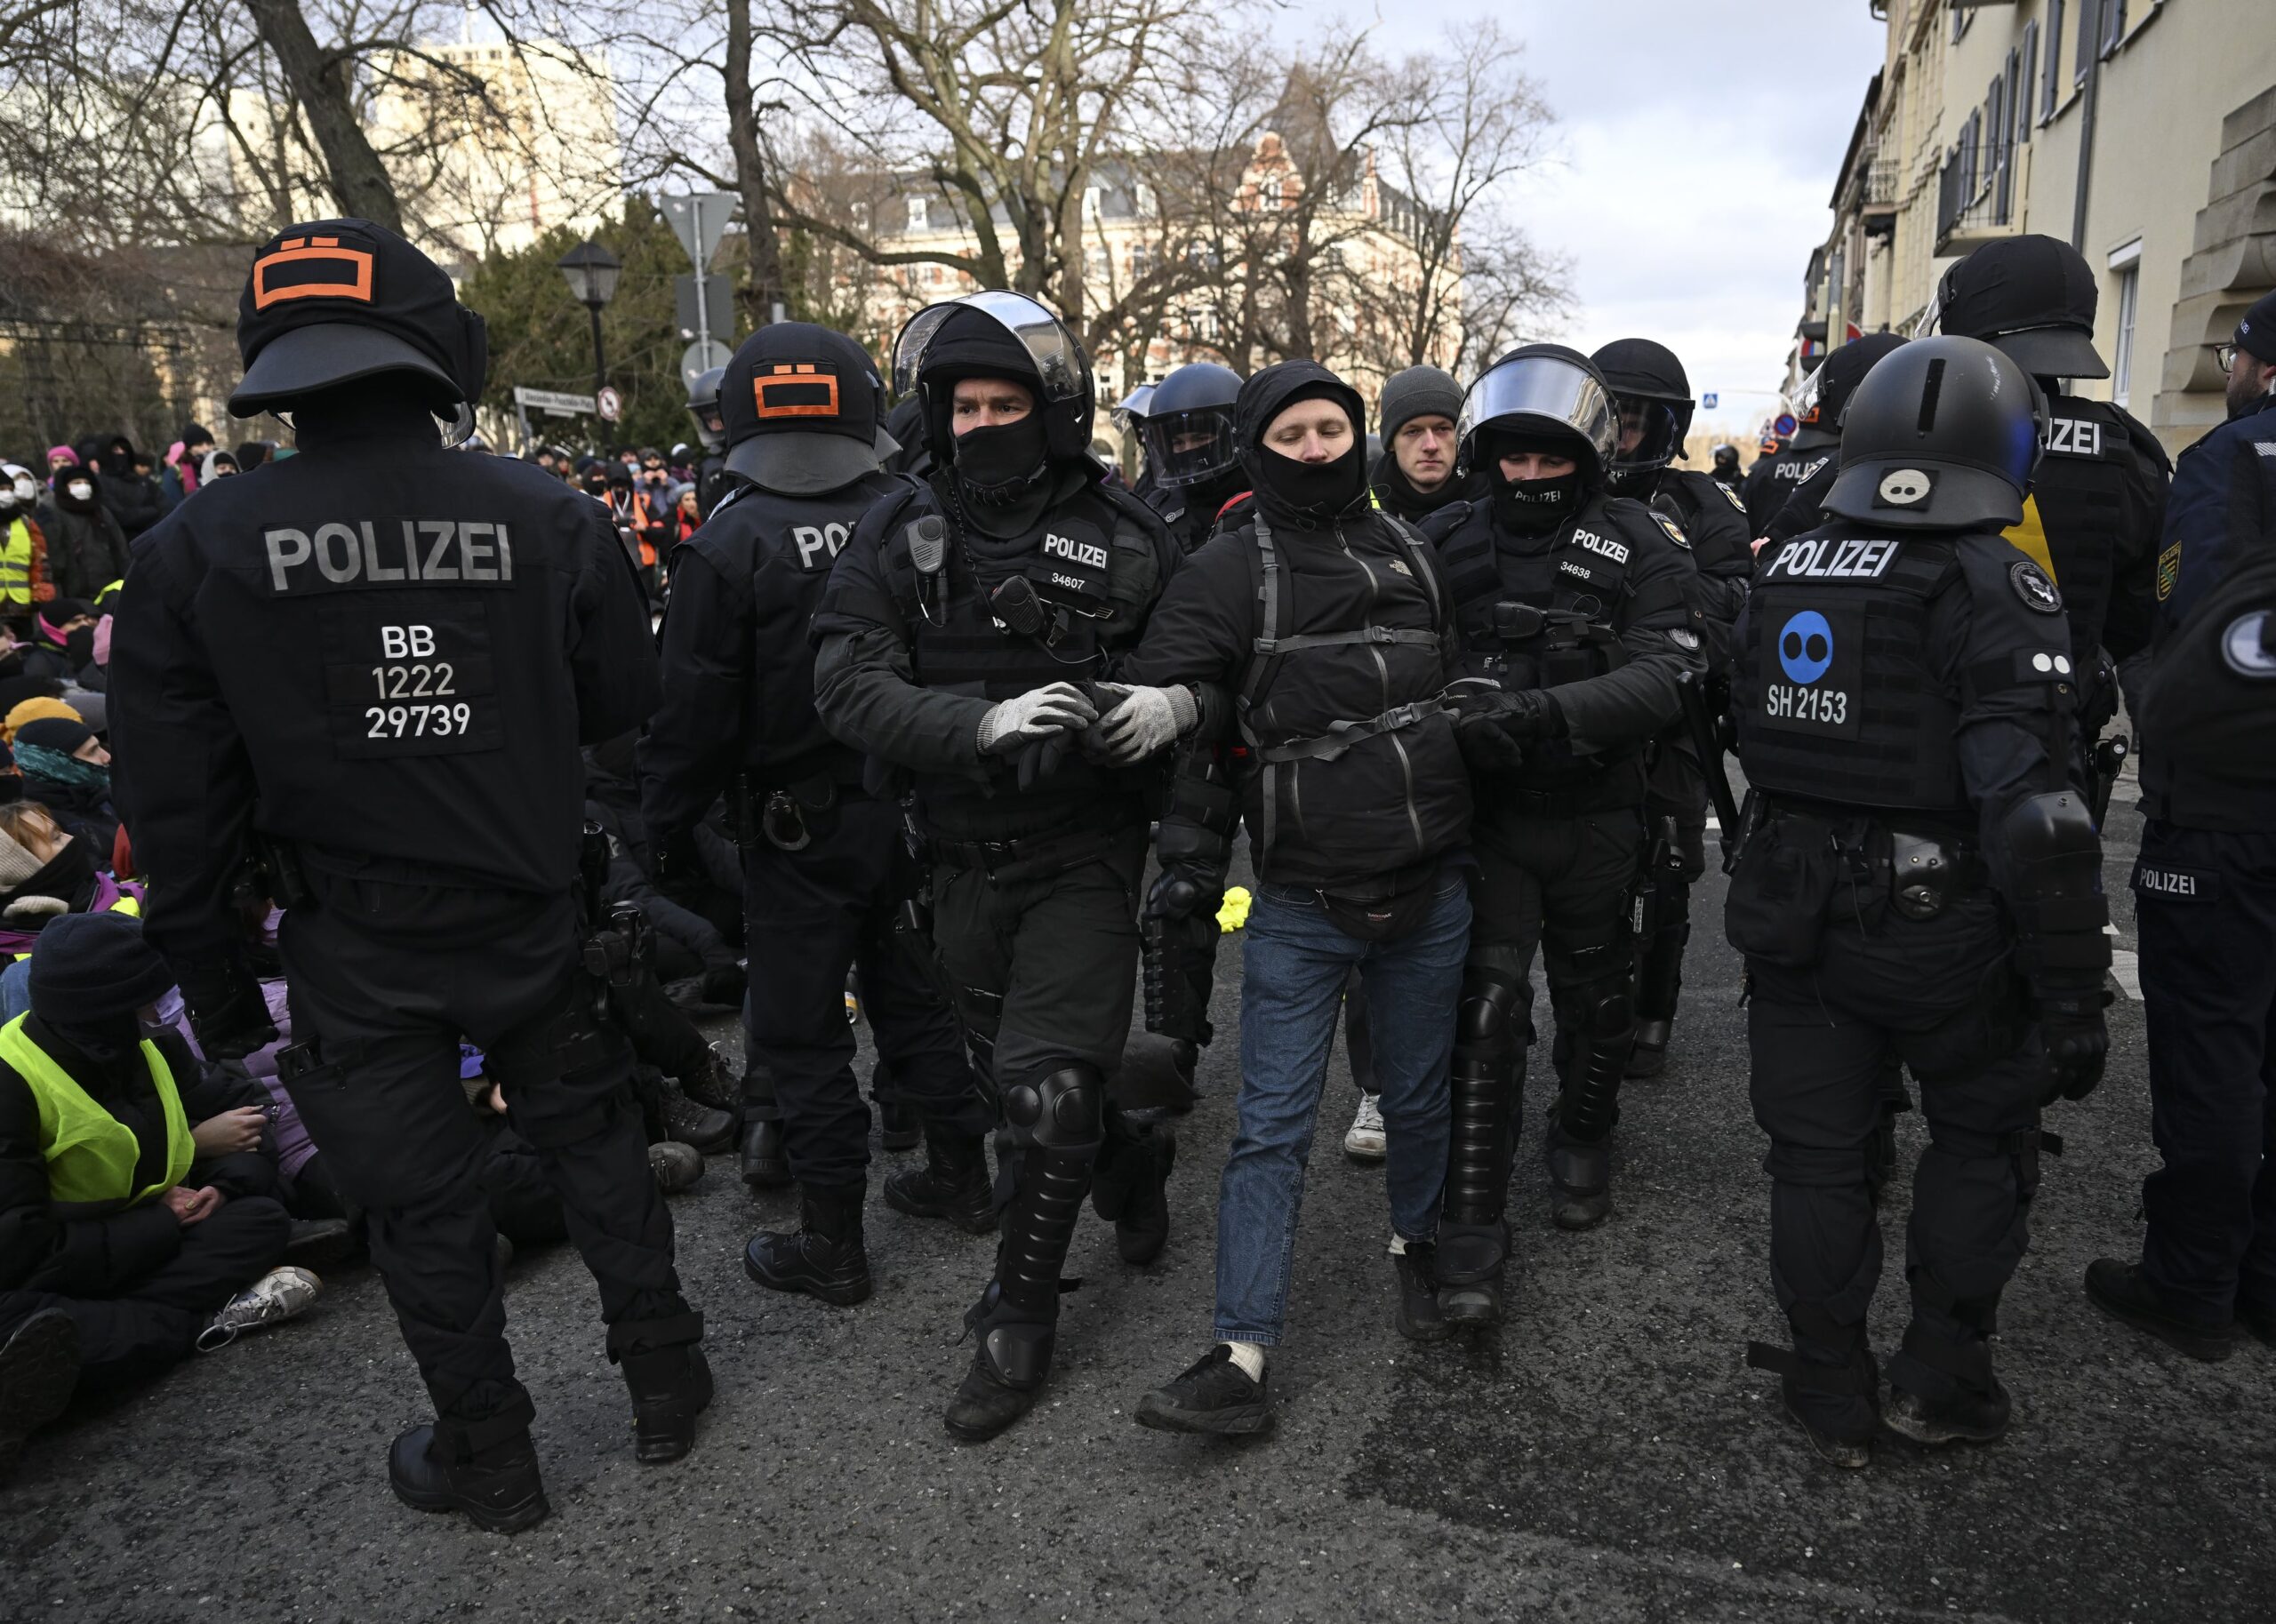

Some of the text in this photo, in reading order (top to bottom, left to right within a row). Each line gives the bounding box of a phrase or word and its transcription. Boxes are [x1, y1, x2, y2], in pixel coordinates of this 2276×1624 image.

[1775, 462, 1815, 479] POLI
[1514, 490, 1561, 503] POLIZEI
[264, 521, 512, 591] POLIZEI
[793, 522, 855, 568] PO
[1045, 533, 1107, 569] POLIZEI
[1572, 529, 1629, 564] POLIZEI
[1767, 540, 1899, 577] POLIZEI
[1052, 572, 1085, 589] 34607
[1560, 562, 1591, 579] 34638
[381, 625, 436, 659] BB
[372, 662, 455, 700] 1222
[365, 702, 470, 738] 29739
[1767, 684, 1847, 724] SH 2153
[2139, 868, 2195, 894] POLIZEI
